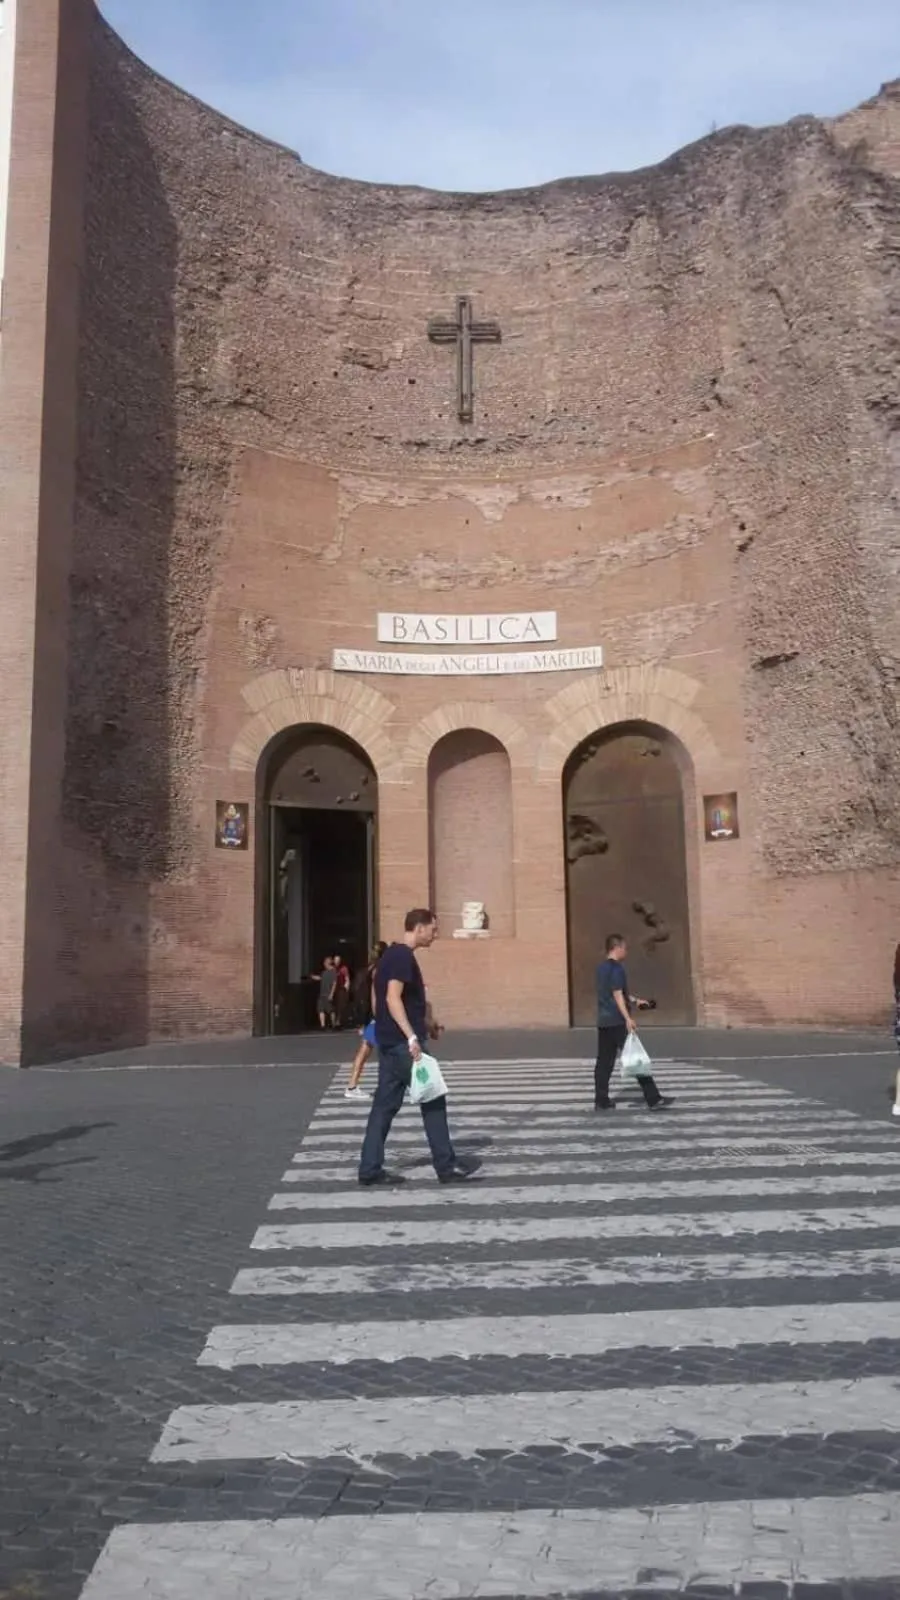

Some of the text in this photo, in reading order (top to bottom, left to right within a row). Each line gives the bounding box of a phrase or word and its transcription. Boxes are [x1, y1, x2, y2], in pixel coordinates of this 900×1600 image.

[392, 615, 541, 641] BASILICA
[354, 655, 403, 670] MARIA
[440, 656, 500, 672] ANGELI
[534, 648, 597, 669] MARTIRI
